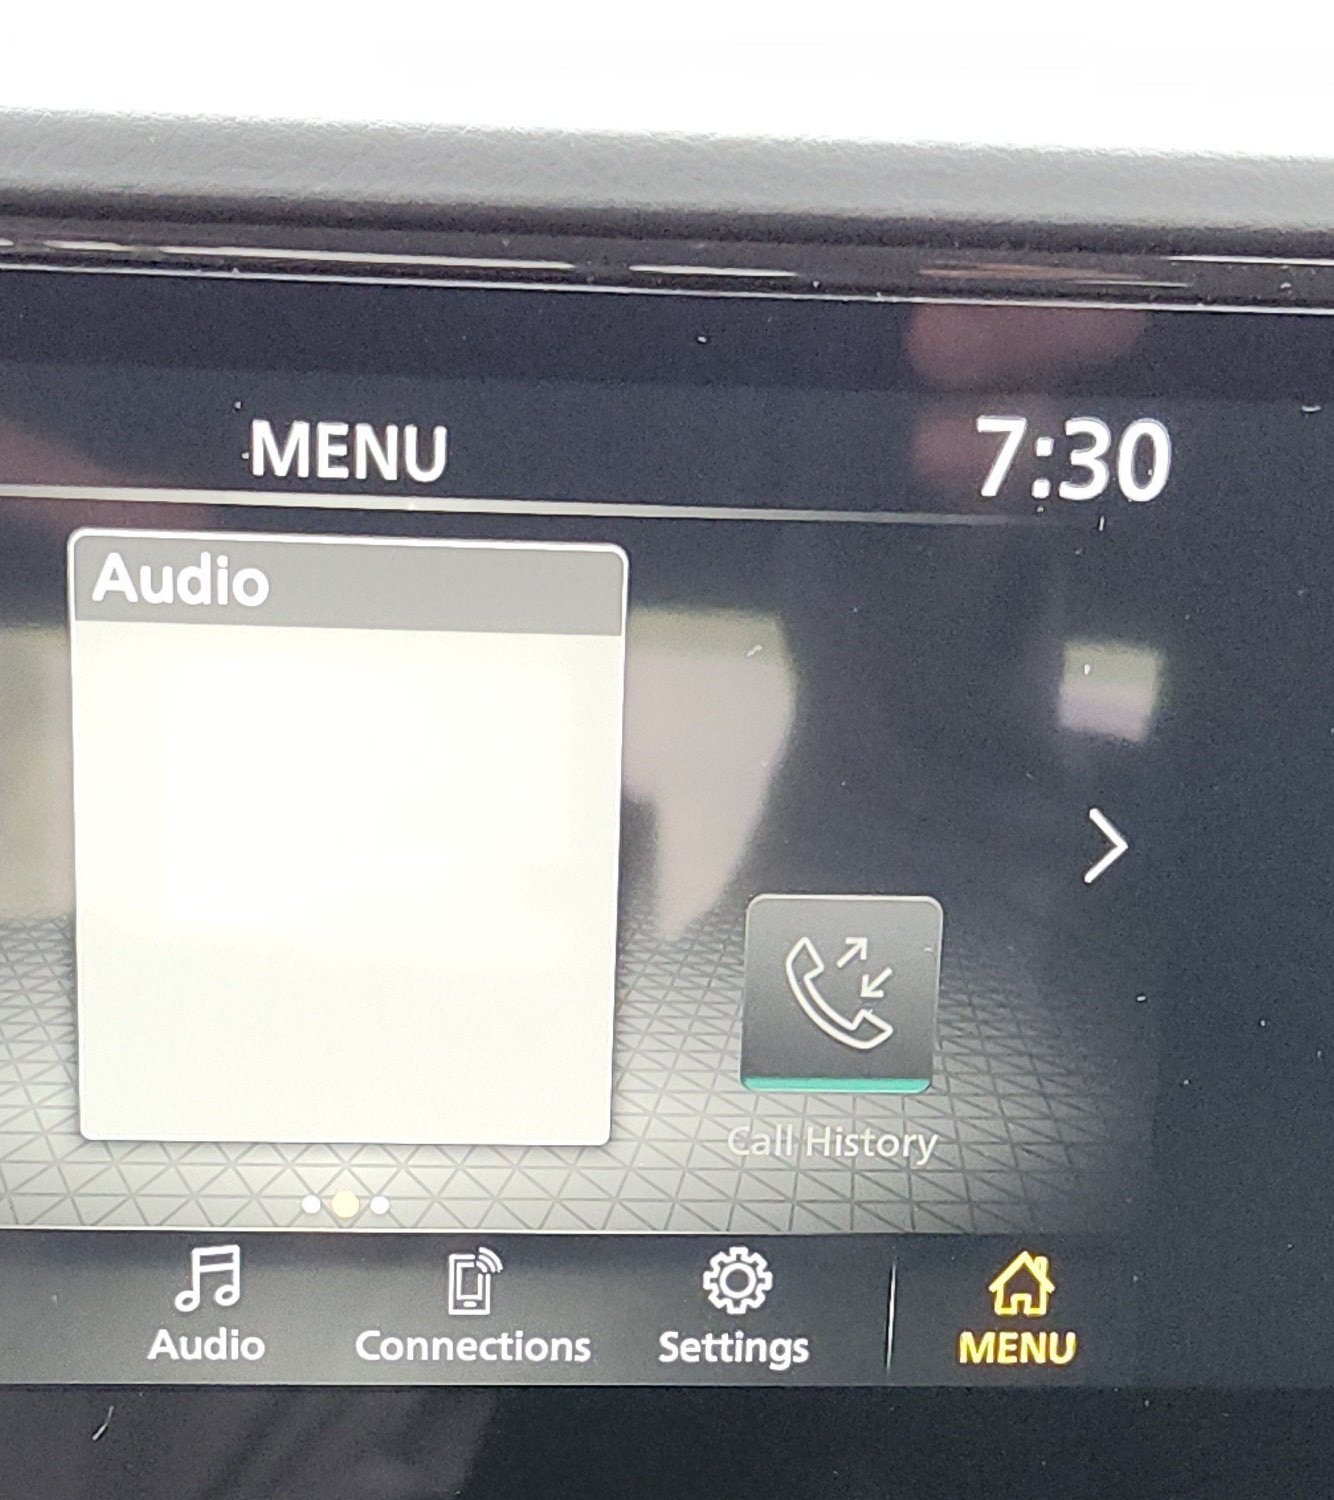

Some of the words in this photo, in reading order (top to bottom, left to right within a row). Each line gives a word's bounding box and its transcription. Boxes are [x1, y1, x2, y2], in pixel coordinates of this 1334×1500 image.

[249, 418, 450, 483] MENU
[974, 414, 1173, 504] 7:30
[91, 552, 270, 608] Audio
[726, 1123, 793, 1158] Call
[805, 1126, 940, 1166] History
[147, 1328, 266, 1362] Audio
[355, 1329, 592, 1364] Connections
[658, 1329, 810, 1371] Settings
[958, 1330, 1077, 1366] MENU
